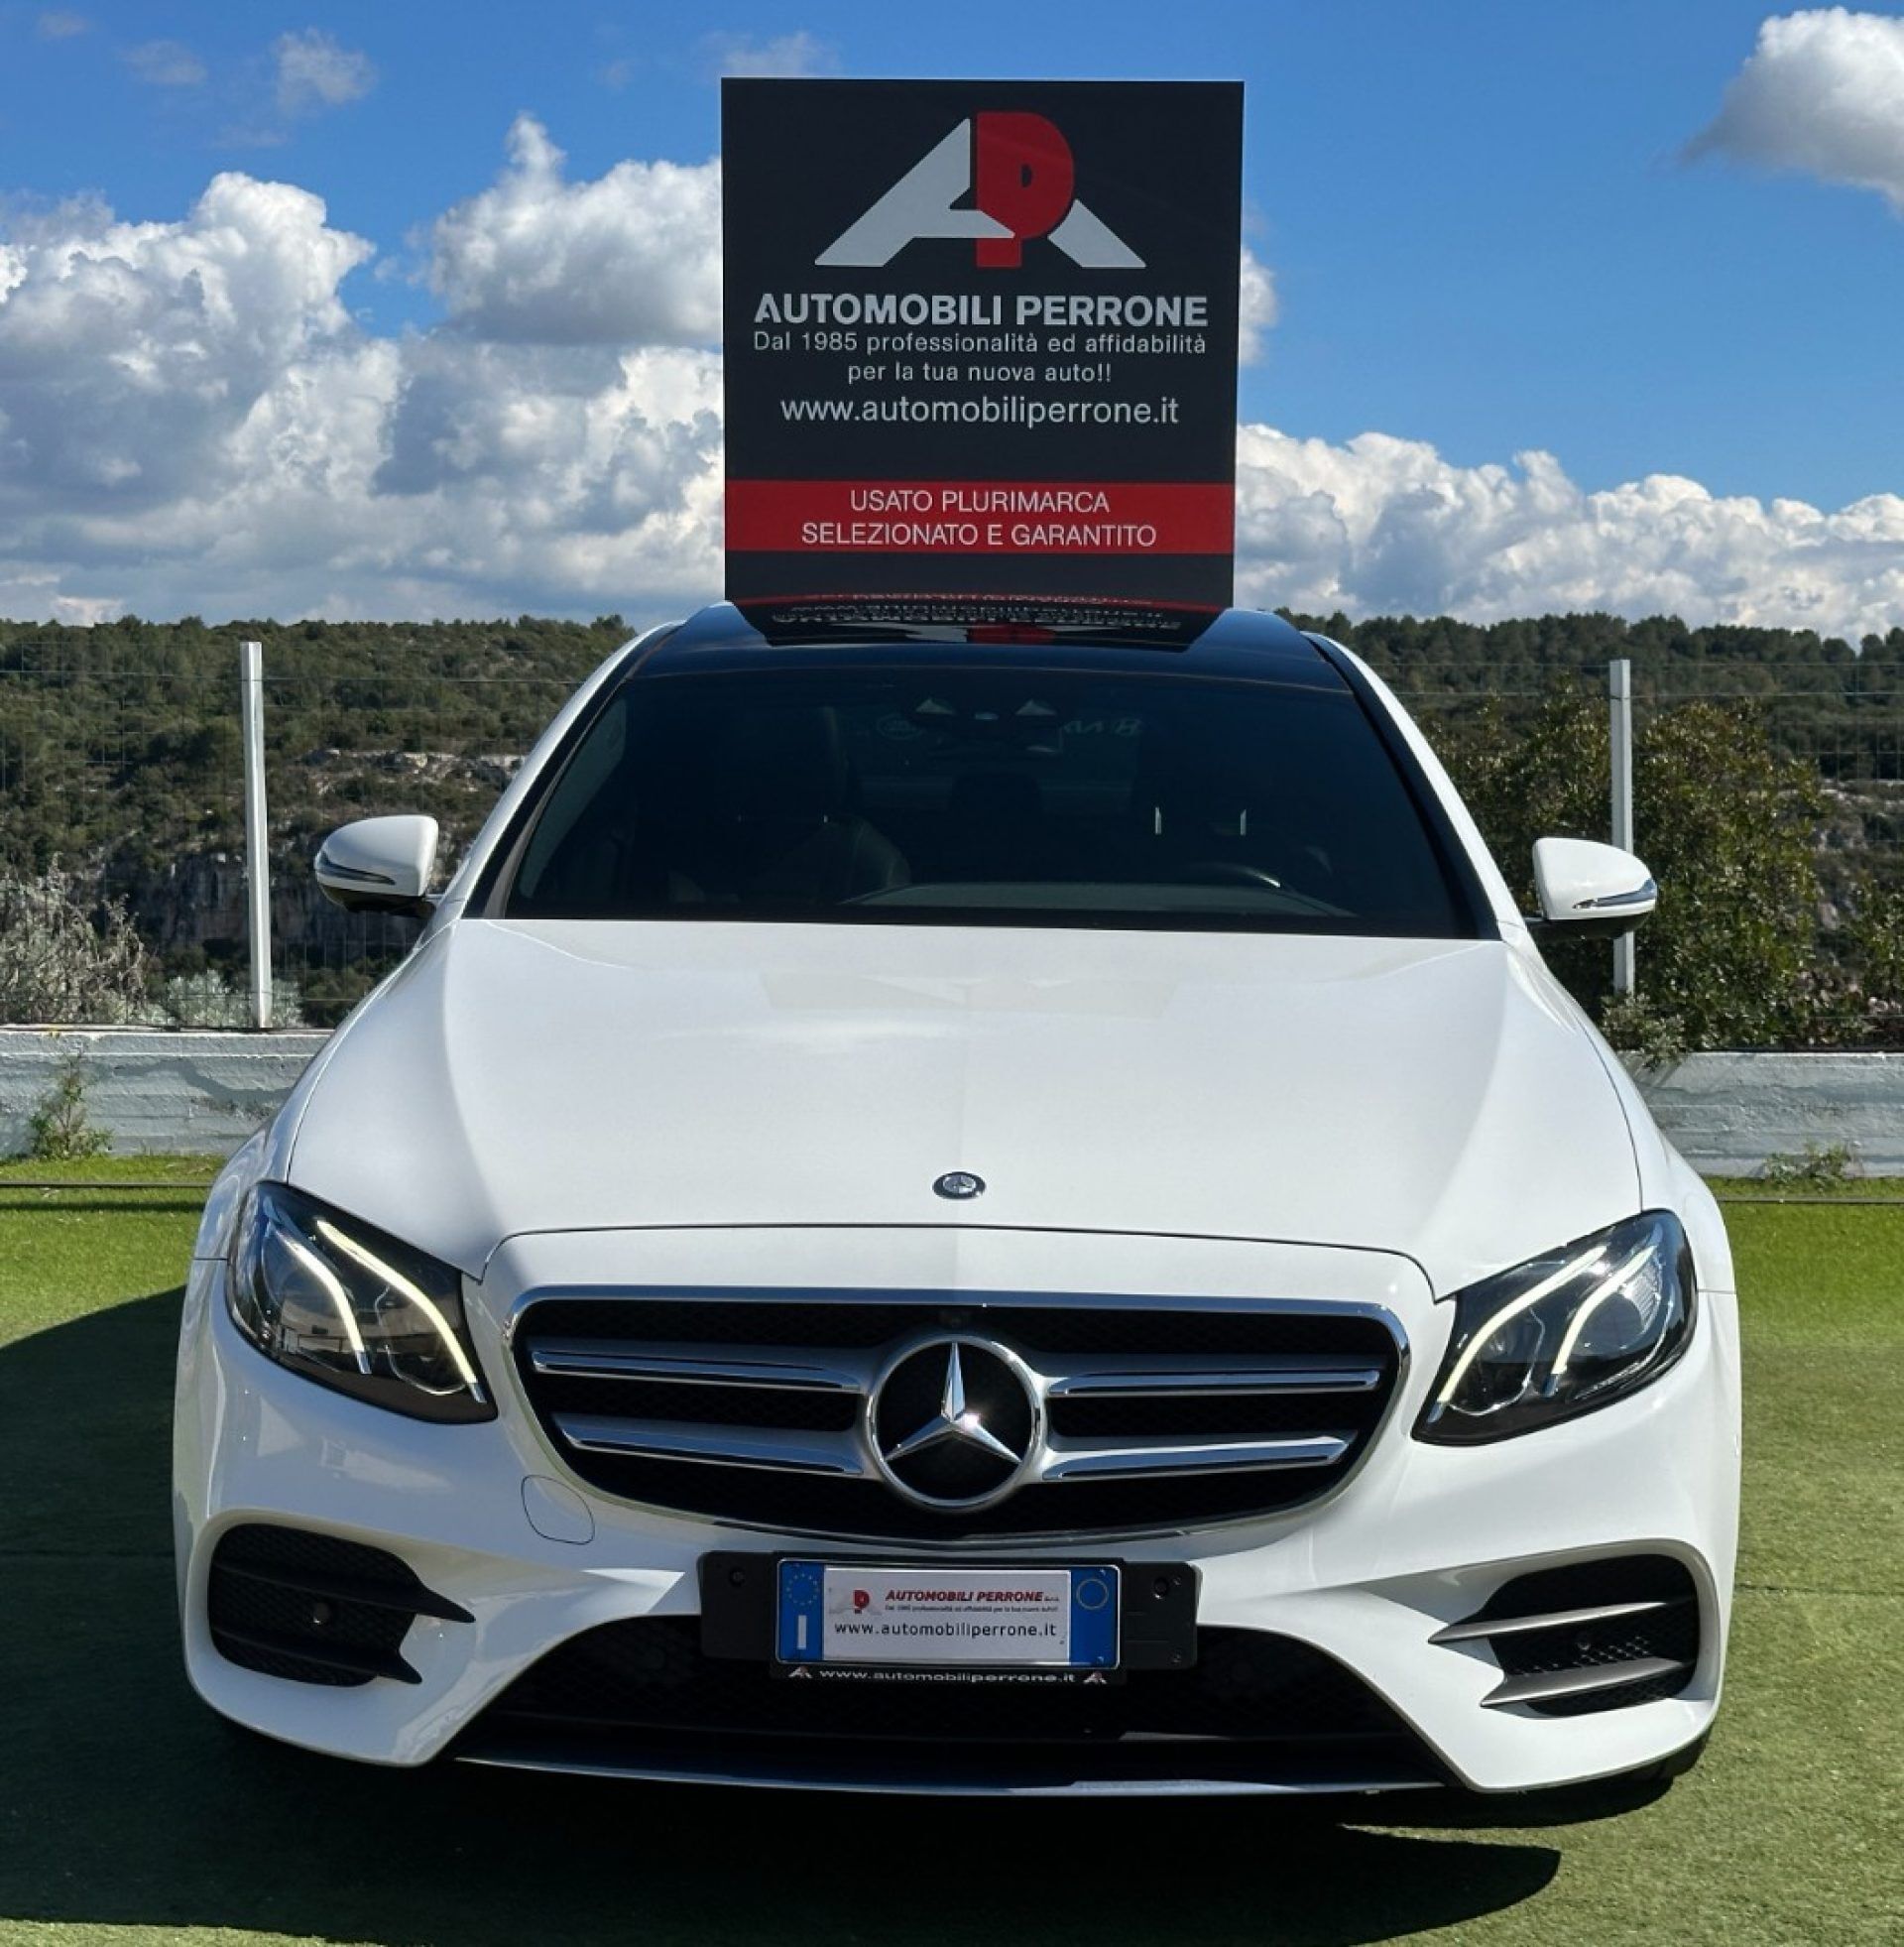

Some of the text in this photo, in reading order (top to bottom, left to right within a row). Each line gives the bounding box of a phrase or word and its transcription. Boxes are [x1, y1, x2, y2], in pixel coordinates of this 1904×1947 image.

[754, 293, 1209, 327] AUTOMOBILI PERRONE
[754, 330, 1206, 355] Dal 1985 professionalità ed affidabilità
[848, 361, 1112, 384] per la tua nuova auto!!
[780, 396, 1180, 429] www.automobiliperrone.it
[850, 490, 1111, 513] USATO PLURIMARCA
[801, 522, 1157, 547] SELEZIONATO E GARANTITO
[885, 1589, 974, 1602] AUTOMOBILI
[976, 1591, 1044, 1602] PERRONE
[833, 1621, 1058, 1640] www.automobiliperrone.it
[818, 1669, 1077, 1683] www.automobiliperrone.it
